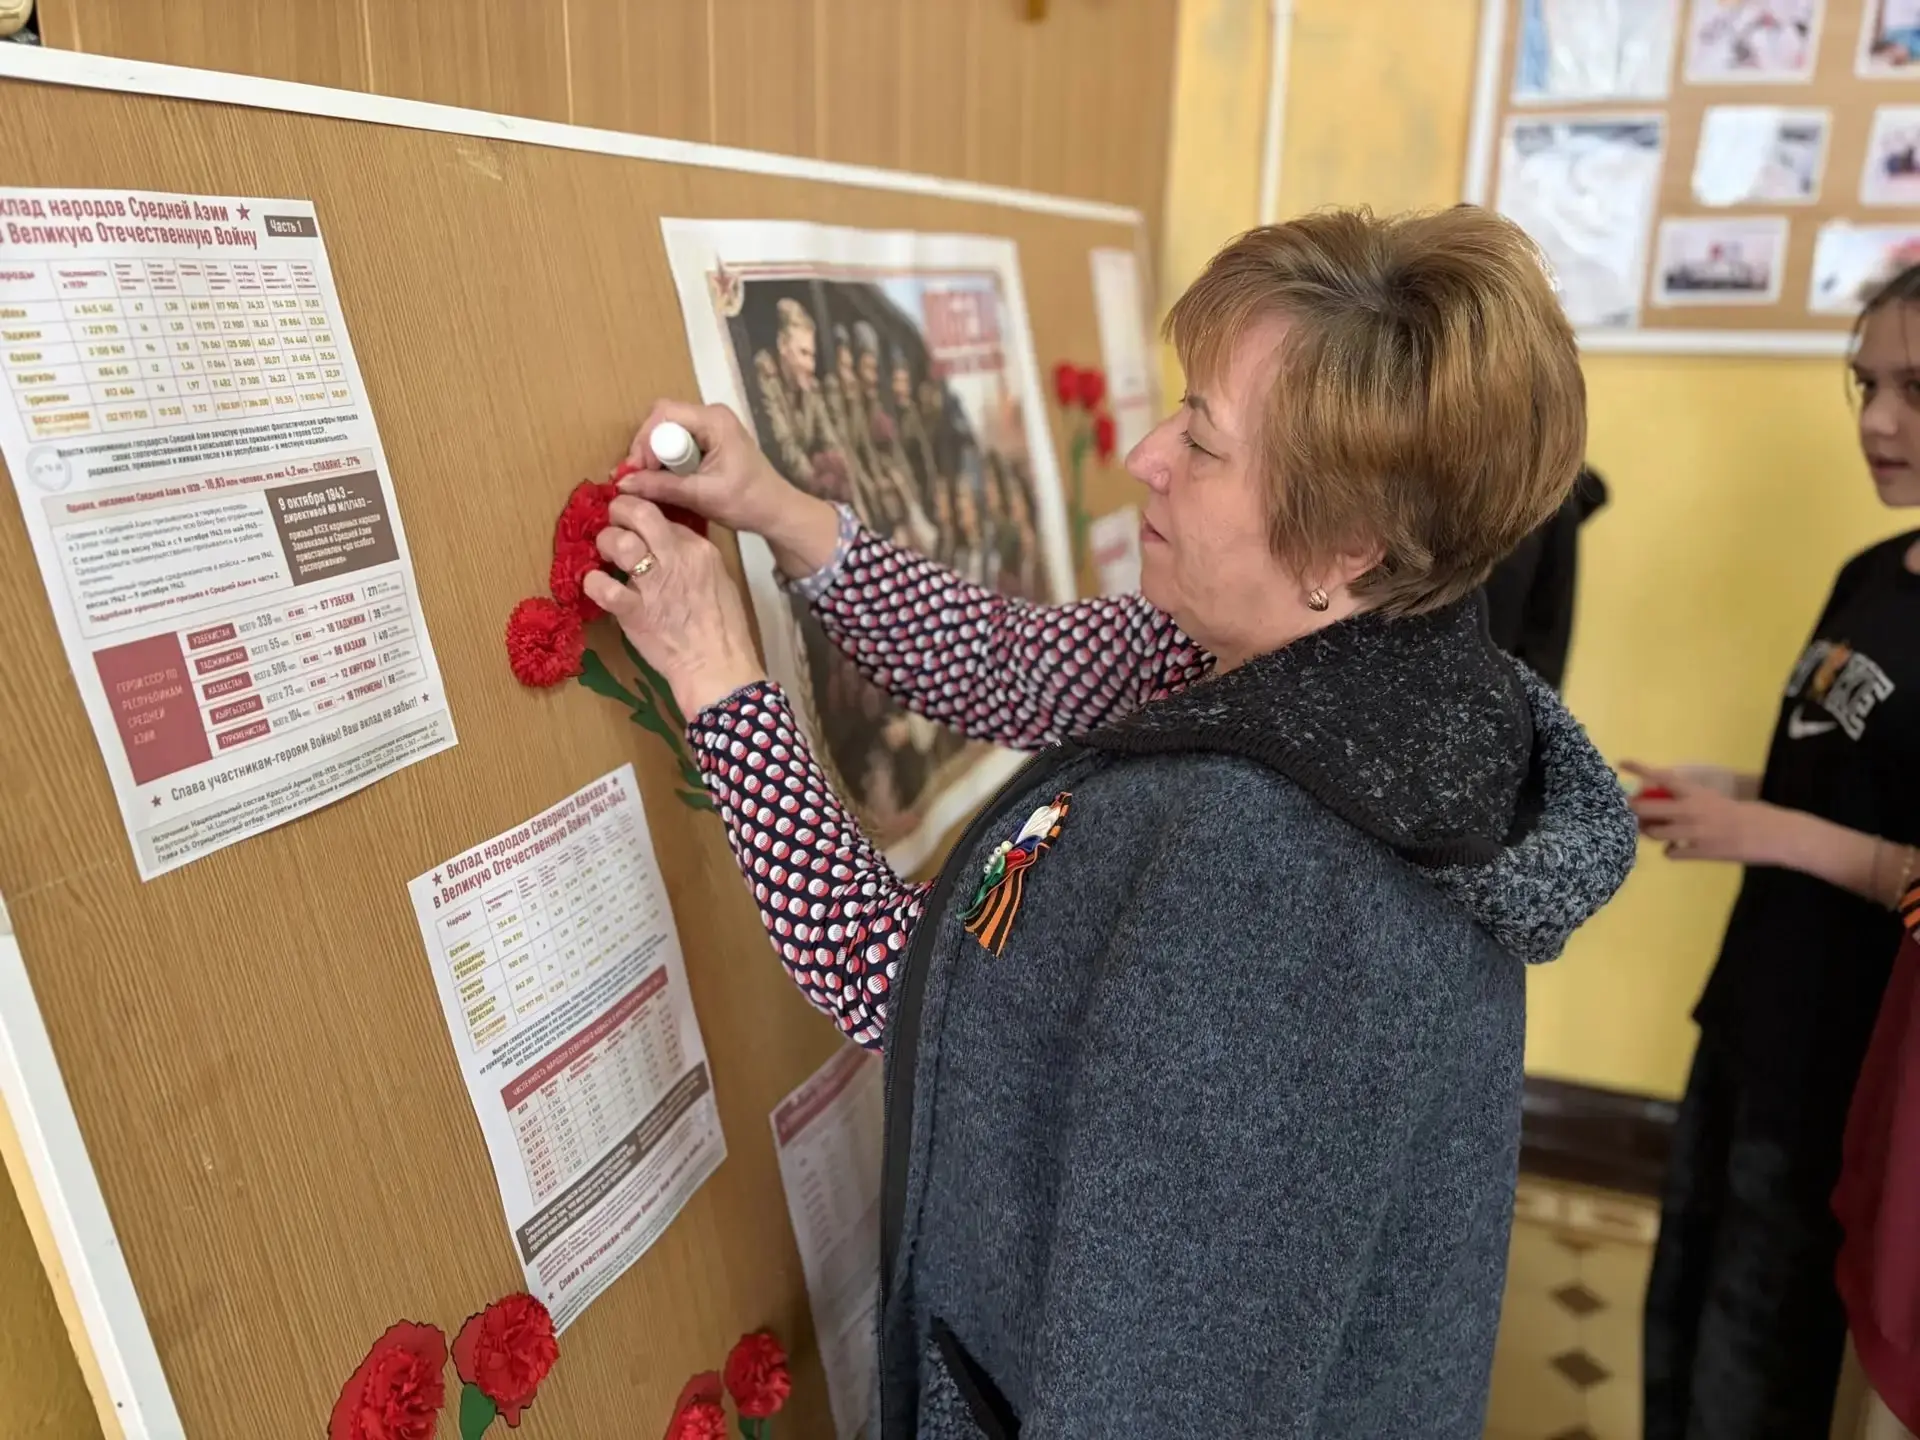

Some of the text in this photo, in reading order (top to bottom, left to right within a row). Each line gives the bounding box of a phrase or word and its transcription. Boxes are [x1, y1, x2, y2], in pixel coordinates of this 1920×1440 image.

[48, 199, 125, 219] народов
[128, 197, 191, 220] Средней
[193, 201, 228, 221] Азии
[269, 219, 302, 232] Часть 1
[7, 222, 93, 247] Великую
[96, 222, 212, 248] Отечественную
[214, 226, 257, 249] Войну
[313, 458, 341, 471] СЛАВЯНЕ
[278, 486, 345, 510] 9 октября 1943
[283, 505, 327, 523] директивой
[192, 628, 230, 644] УЗБЕКИСТАН
[256, 613, 272, 627] 338
[329, 592, 354, 606] УЗБЕКИ
[268, 636, 280, 649] 55
[335, 613, 365, 629] ТАДЖИКИ
[207, 678, 242, 694] КАЗАХСТАН
[343, 637, 366, 652] КАЗАХИ
[215, 700, 256, 719] КЫРГЫЗСТАН
[282, 684, 294, 696] 73
[340, 667, 348, 677] 12
[348, 658, 376, 674] КИРГИЗЫ
[288, 708, 301, 721] 104
[353, 679, 382, 697] ТУРКМЕНЫ
[170, 696, 417, 800] Слава участникам-героям Войны! Ваш вклад не забыт!
[190, 802, 241, 827] Национальный
[265, 782, 292, 798] Красной
[446, 852, 483, 879] Вклад
[484, 828, 530, 859] народов
[530, 801, 575, 835] Северного
[575, 782, 607, 808] Кавказа
[432, 895, 440, 908] в
[441, 868, 491, 903] Великую
[492, 826, 566, 875] Отечественную
[566, 811, 591, 833] Войну
[446, 910, 471, 927] Народы
[558, 1267, 579, 1290] Слава
